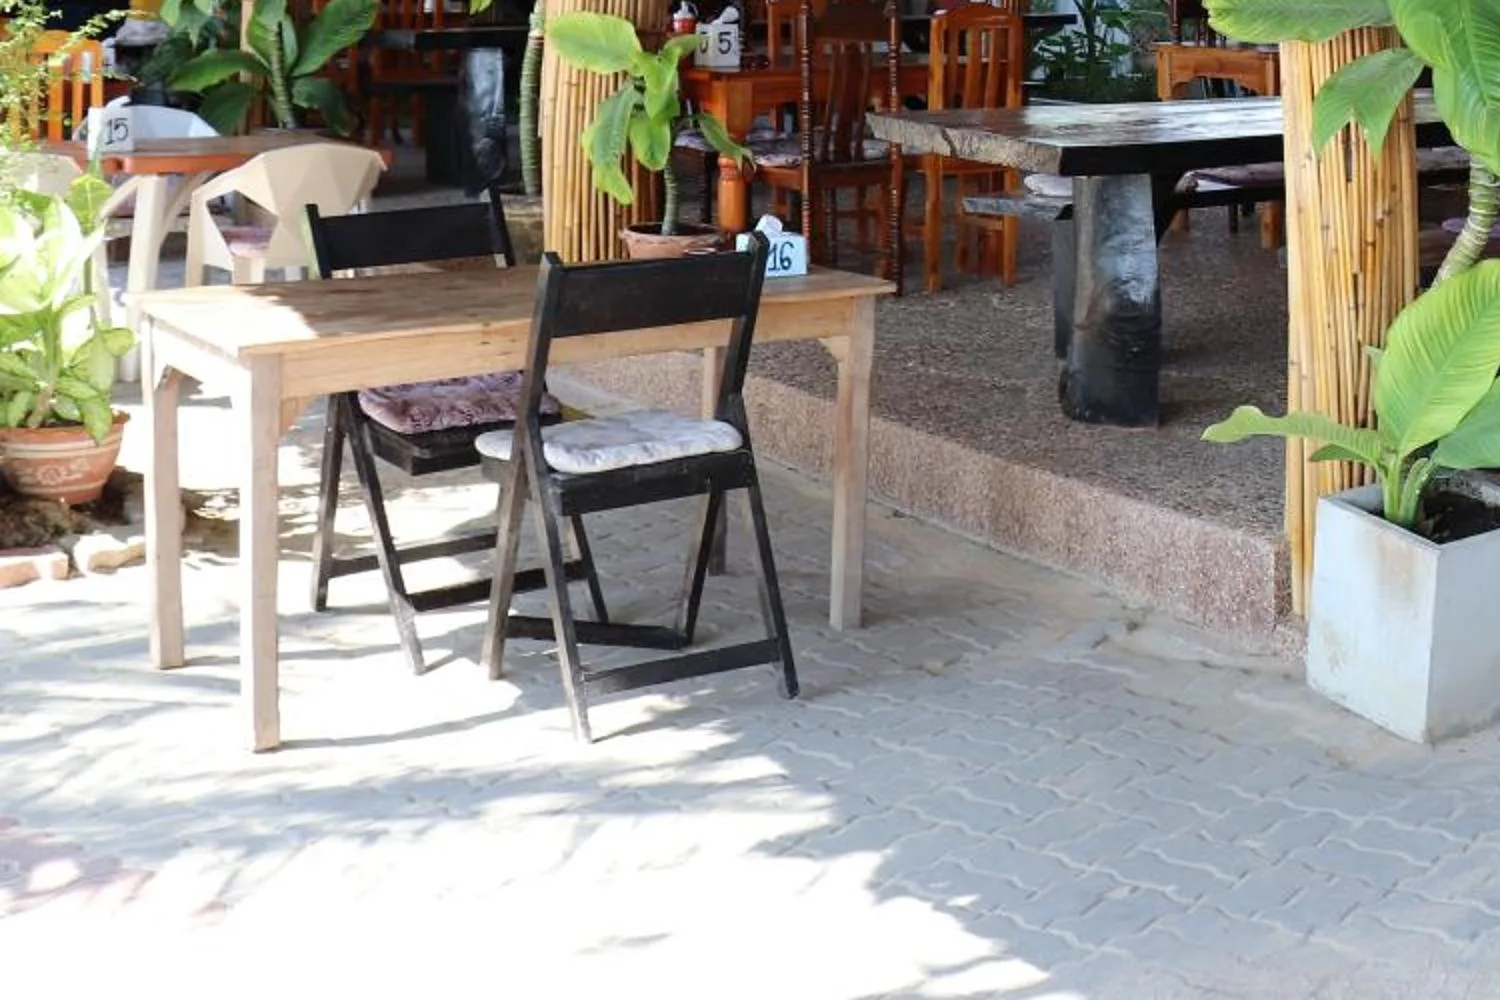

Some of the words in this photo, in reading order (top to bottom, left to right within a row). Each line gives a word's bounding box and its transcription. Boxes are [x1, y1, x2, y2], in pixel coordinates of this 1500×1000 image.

[718, 31, 732, 55] 5
[104, 117, 129, 145] 15
[767, 241, 795, 271] 16
